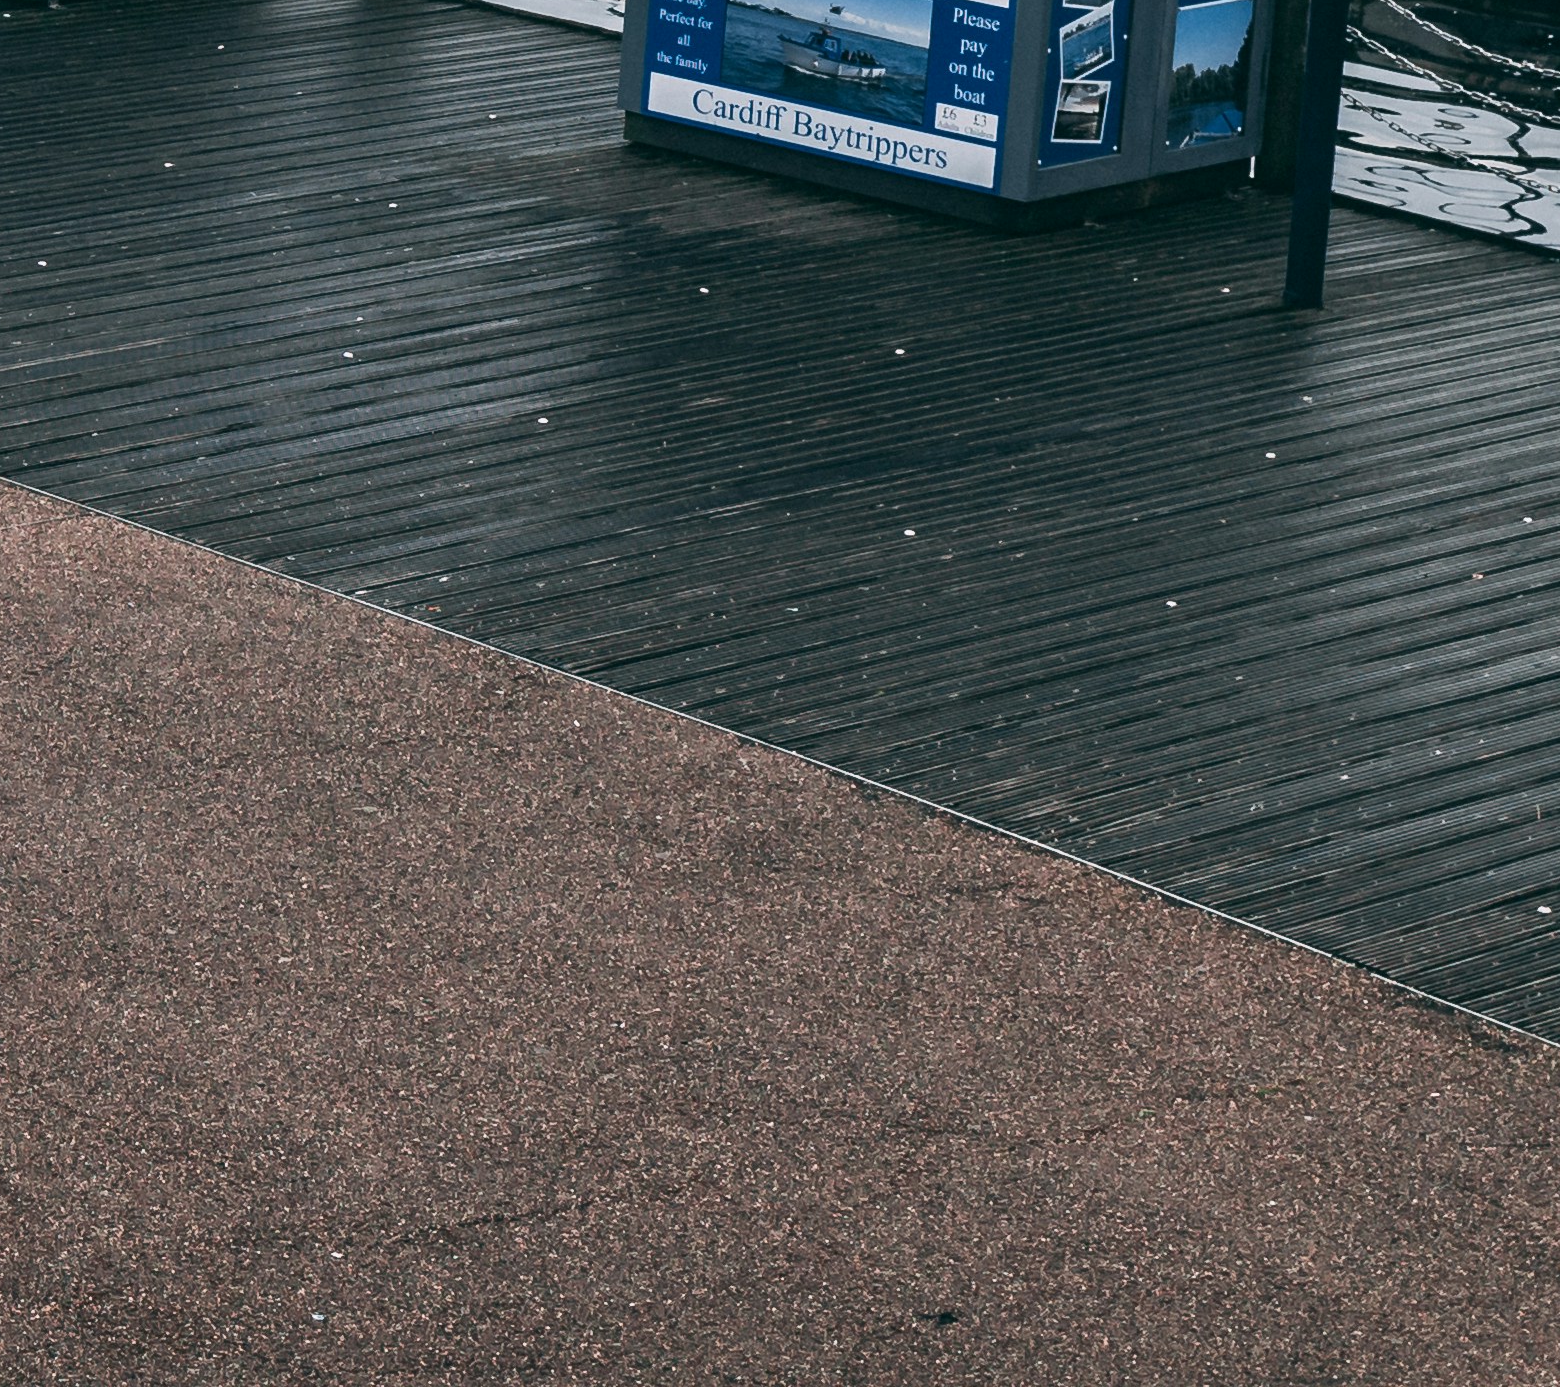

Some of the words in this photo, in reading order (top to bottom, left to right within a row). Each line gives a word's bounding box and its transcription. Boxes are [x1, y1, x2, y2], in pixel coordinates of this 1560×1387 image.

[659, 8, 695, 27] Perfect
[697, 16, 714, 30] for
[953, 7, 1001, 32] Please
[960, 36, 989, 57] pay
[656, 50, 673, 64] the
[675, 54, 709, 74] family
[948, 61, 969, 76] on
[972, 62, 995, 82] the
[953, 84, 986, 106] boat
[692, 88, 788, 133] Cardiff
[792, 110, 948, 170] Baytrippers
